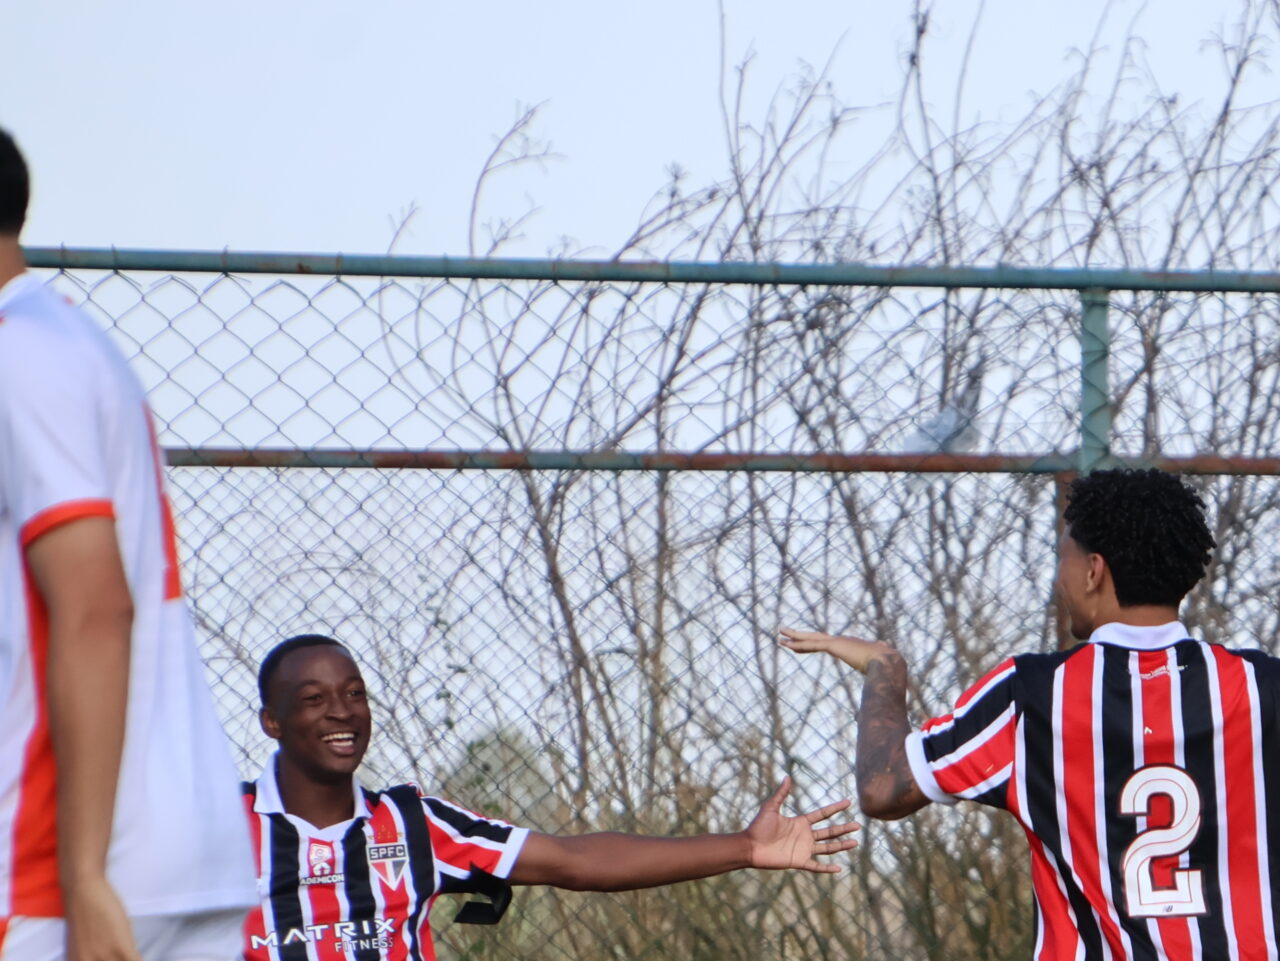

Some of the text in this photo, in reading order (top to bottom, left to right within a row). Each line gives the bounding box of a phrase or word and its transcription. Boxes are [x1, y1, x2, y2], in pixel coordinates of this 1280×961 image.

[1120, 766, 1206, 917] 2
[369, 845, 404, 860] SPFC
[300, 873, 345, 885] ADEMICON
[250, 918, 396, 950] MATRIX
[334, 937, 394, 953] FITNESS
